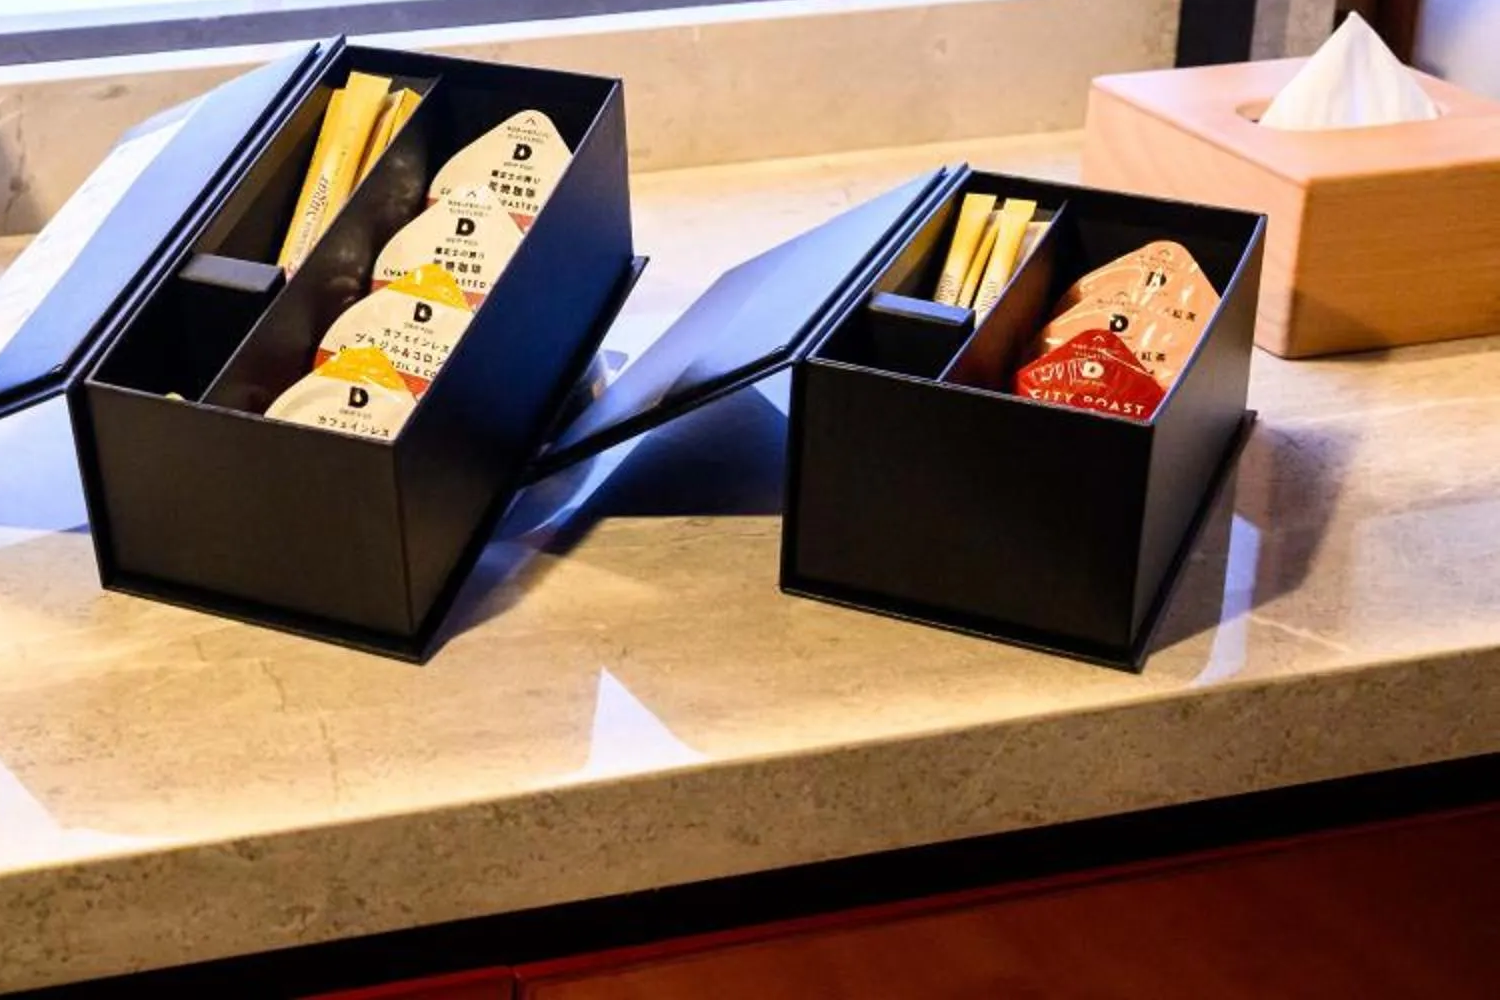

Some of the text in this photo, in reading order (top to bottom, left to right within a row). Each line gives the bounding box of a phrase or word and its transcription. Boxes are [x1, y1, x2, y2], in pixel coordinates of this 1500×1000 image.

[455, 217, 476, 236] D
[413, 301, 433, 323] D
[348, 386, 369, 408] D
[1028, 389, 1074, 403] CITY
